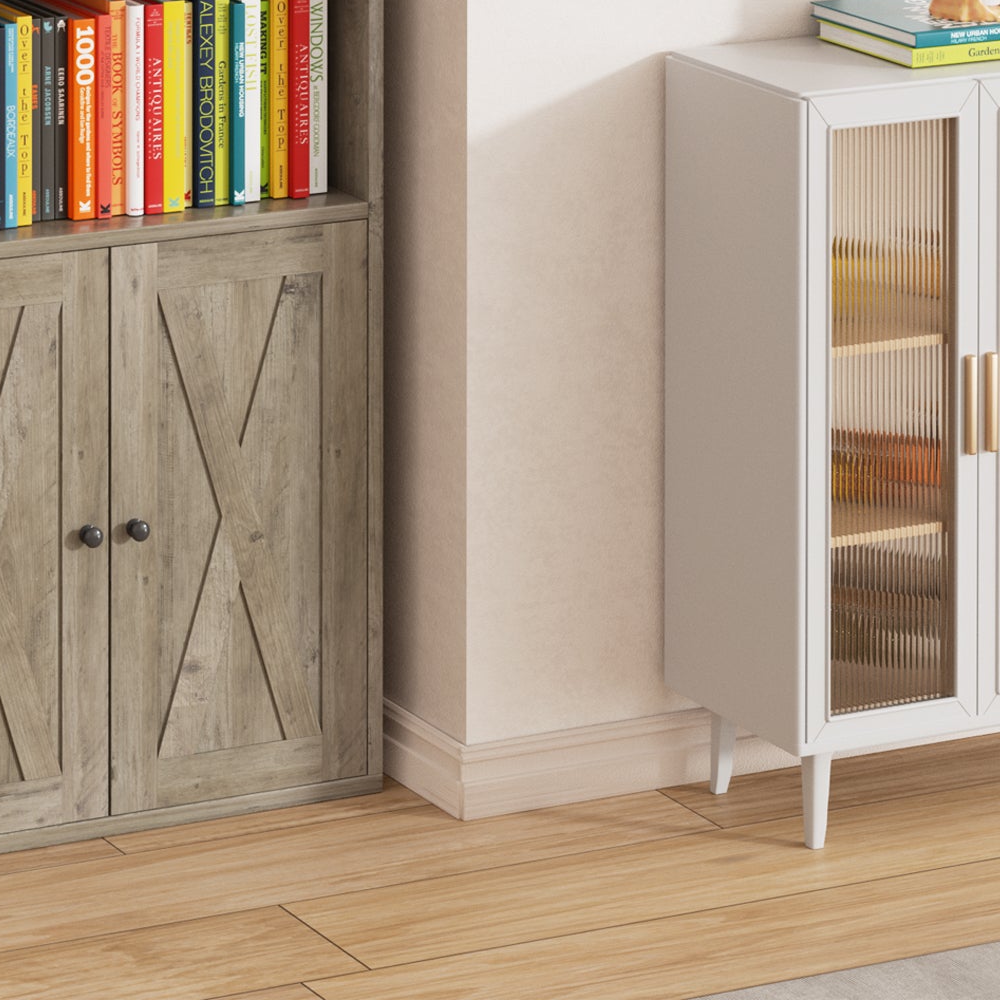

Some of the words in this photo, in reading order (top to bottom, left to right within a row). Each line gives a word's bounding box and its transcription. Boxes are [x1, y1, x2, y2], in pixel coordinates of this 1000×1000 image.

[200, 0, 214, 70] ALEXEY
[260, 10, 268, 60] MAKING
[278, 1, 286, 48] Over
[310, 1, 324, 82] WINDOWS
[966, 28, 988, 38] URBAN
[20, 24, 29, 72] Over
[76, 26, 95, 86] 1000
[260, 62, 268, 76] IT
[968, 46, 1000, 58] Garden
[44, 66, 52, 86] ARNE
[112, 52, 123, 94] BOOK
[218, 60, 226, 101] Gardens
[298, 44, 308, 145] ANTIQUAIRES
[44, 88, 52, 126] JACOBSEN
[150, 58, 162, 160] ANTIQUAIRES
[218, 104, 226, 113] in
[278, 108, 286, 149] Top
[6, 104, 16, 159] BORDEAUX
[112, 110, 123, 186] SYMBOLS
[200, 76, 214, 194] BRODOVITCH
[218, 116, 226, 149] France
[20, 134, 29, 176] Top
